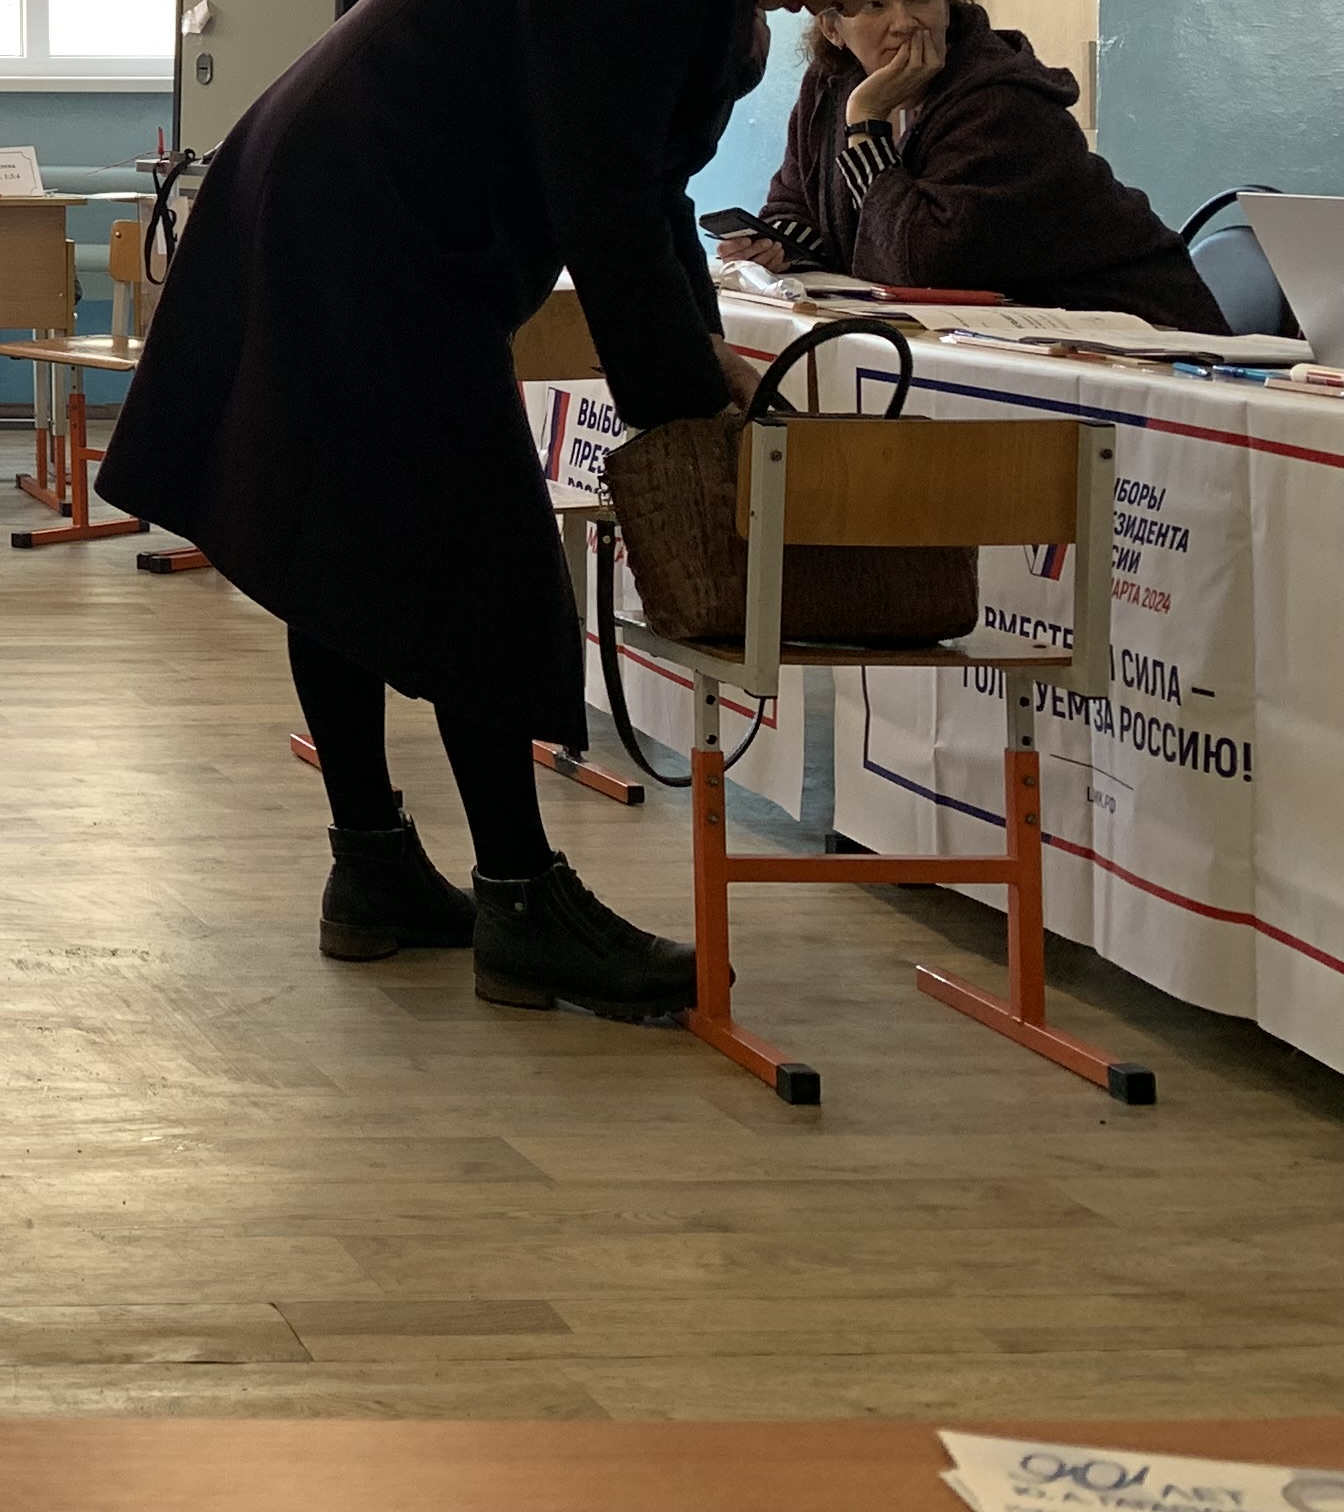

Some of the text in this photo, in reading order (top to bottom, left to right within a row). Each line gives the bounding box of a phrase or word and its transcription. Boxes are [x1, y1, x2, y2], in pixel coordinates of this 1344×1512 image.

[576, 397, 622, 438] ВЫБО
[1114, 477, 1167, 512] БОРЫ
[1113, 510, 1190, 553] ЗИДЕНТА
[1111, 577, 1171, 615] АРТА 2024
[1122, 648, 1182, 706] СИЛА
[1092, 698, 1115, 738] ЗА
[1120, 705, 1253, 783] РОССИЮ!
